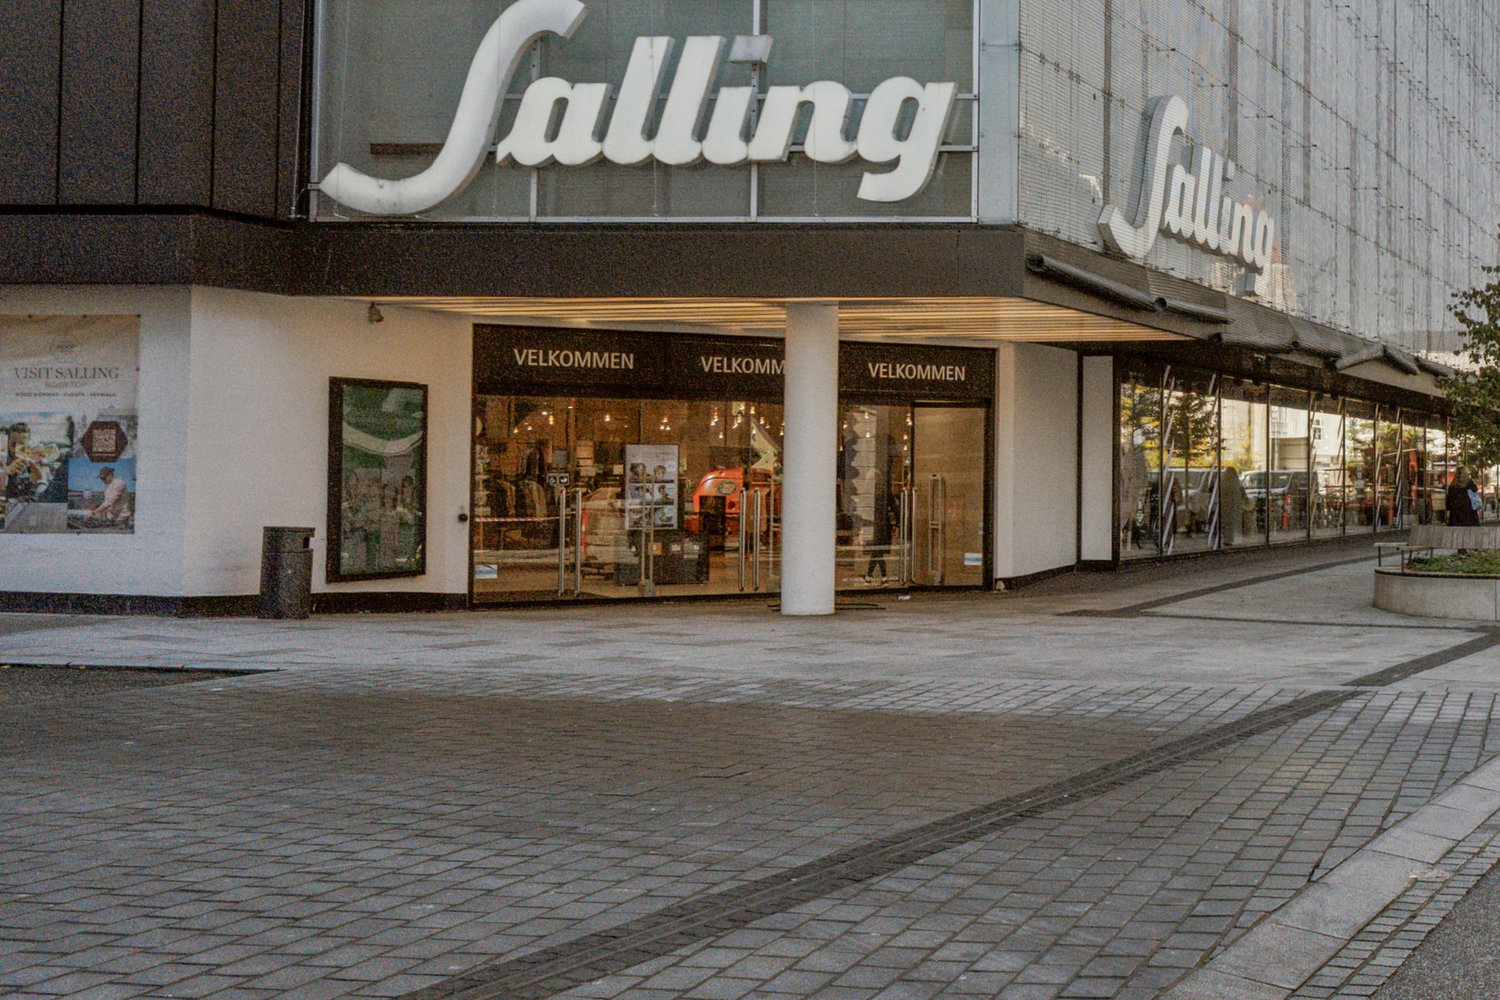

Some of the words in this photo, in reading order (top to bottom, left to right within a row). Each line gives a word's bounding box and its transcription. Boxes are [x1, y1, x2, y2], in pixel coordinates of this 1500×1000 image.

[1098, 96, 1275, 297] Salling
[513, 348, 634, 370] VELKOMMEN
[701, 356, 785, 375] VELKOMM
[14, 366, 53, 379] VISIT
[55, 366, 119, 380] SALLING
[868, 362, 966, 381] VELKOMMEN
